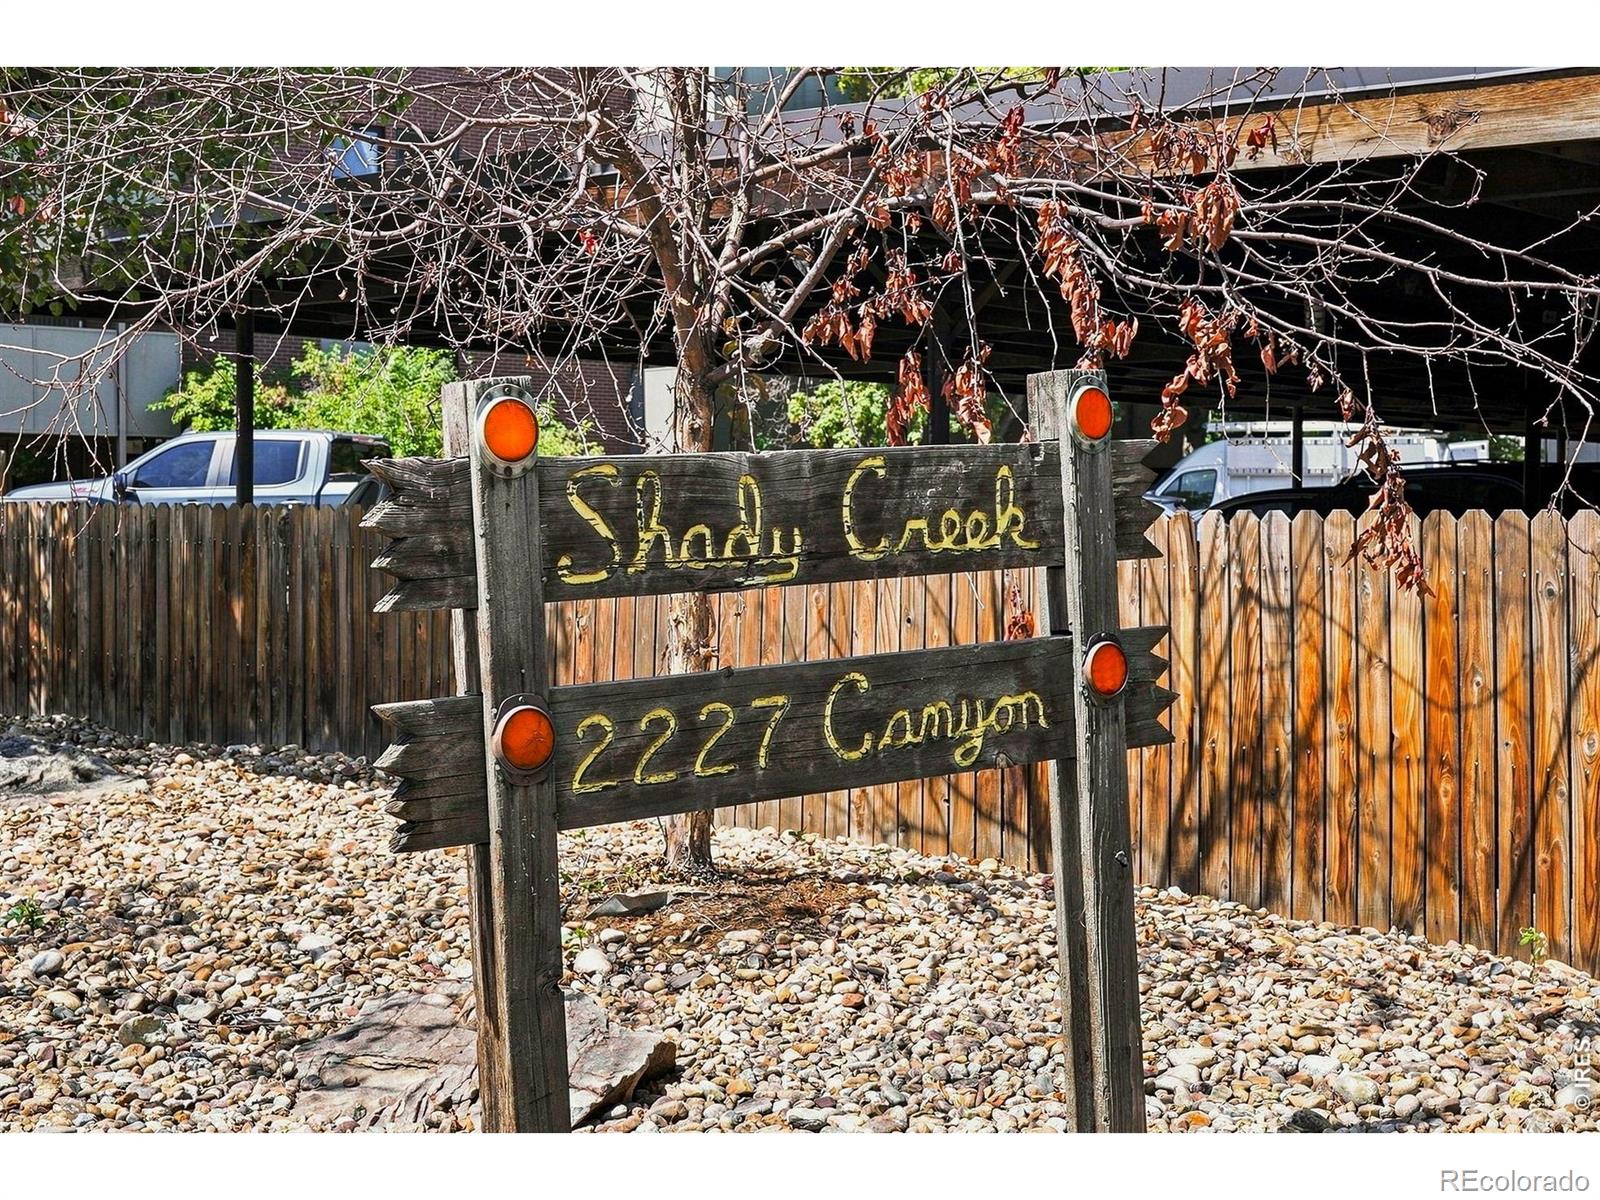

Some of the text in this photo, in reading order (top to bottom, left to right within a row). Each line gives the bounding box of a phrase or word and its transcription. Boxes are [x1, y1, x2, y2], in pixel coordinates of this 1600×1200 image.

[557, 455, 1042, 586] Shady Creek
[572, 671, 1050, 794] 2227 Canyon
